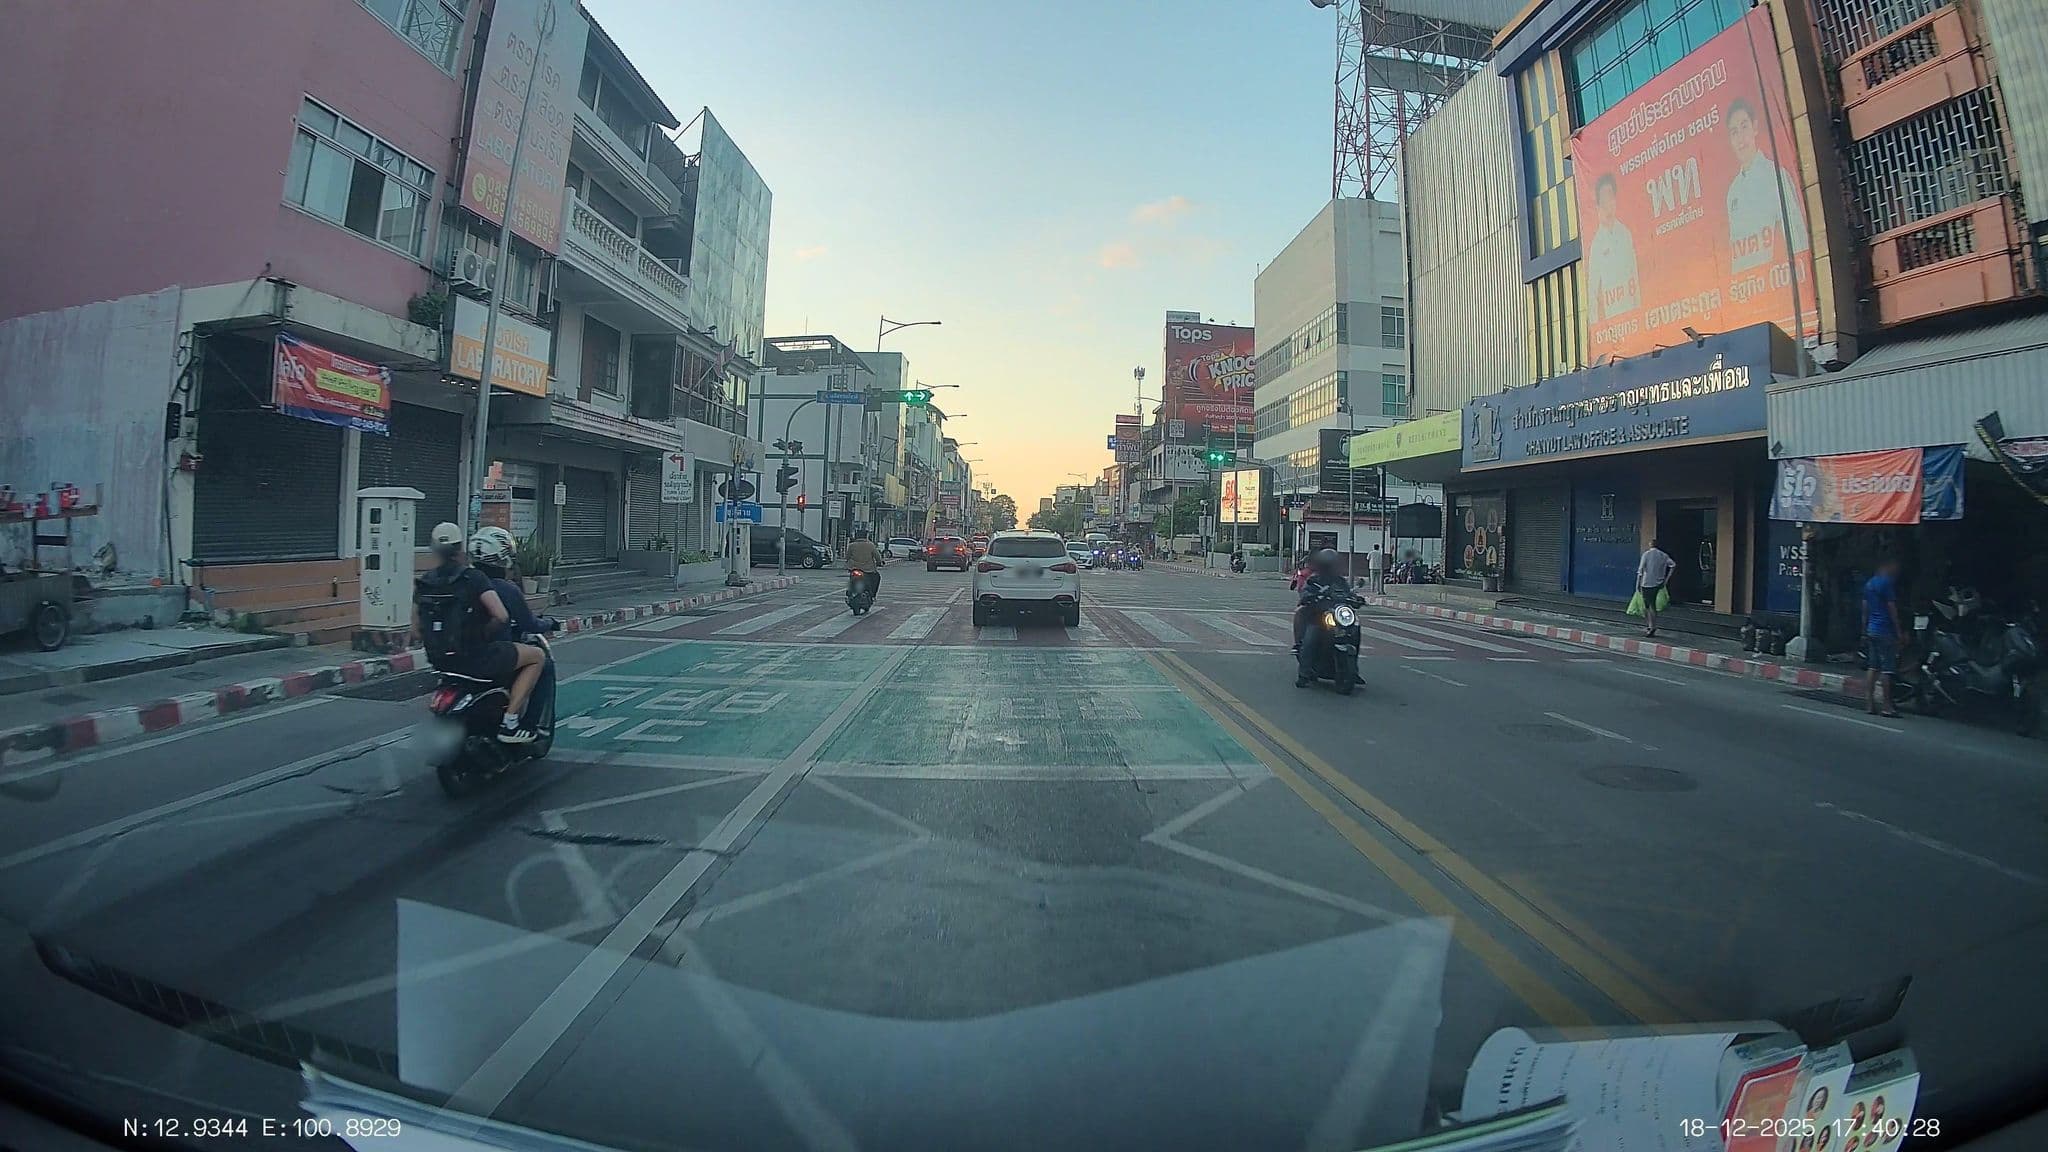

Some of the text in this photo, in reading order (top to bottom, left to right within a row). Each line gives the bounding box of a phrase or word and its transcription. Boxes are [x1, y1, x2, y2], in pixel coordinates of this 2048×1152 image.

[506, 31, 561, 90] ตรวโรค
[1608, 58, 1728, 157] ศูนย์ประสานงาน
[1619, 104, 1720, 176] พรรคเพื่อไทย ชลบุรี
[476, 131, 560, 196] LABOATORY
[1171, 325, 1212, 343] Tops
[457, 342, 543, 388] LABRATORY
[1208, 355, 1256, 379] KNOC
[1223, 373, 1255, 391] PRIC
[1562, 431, 1585, 452] LAW
[1583, 425, 1618, 449] OFFICE
